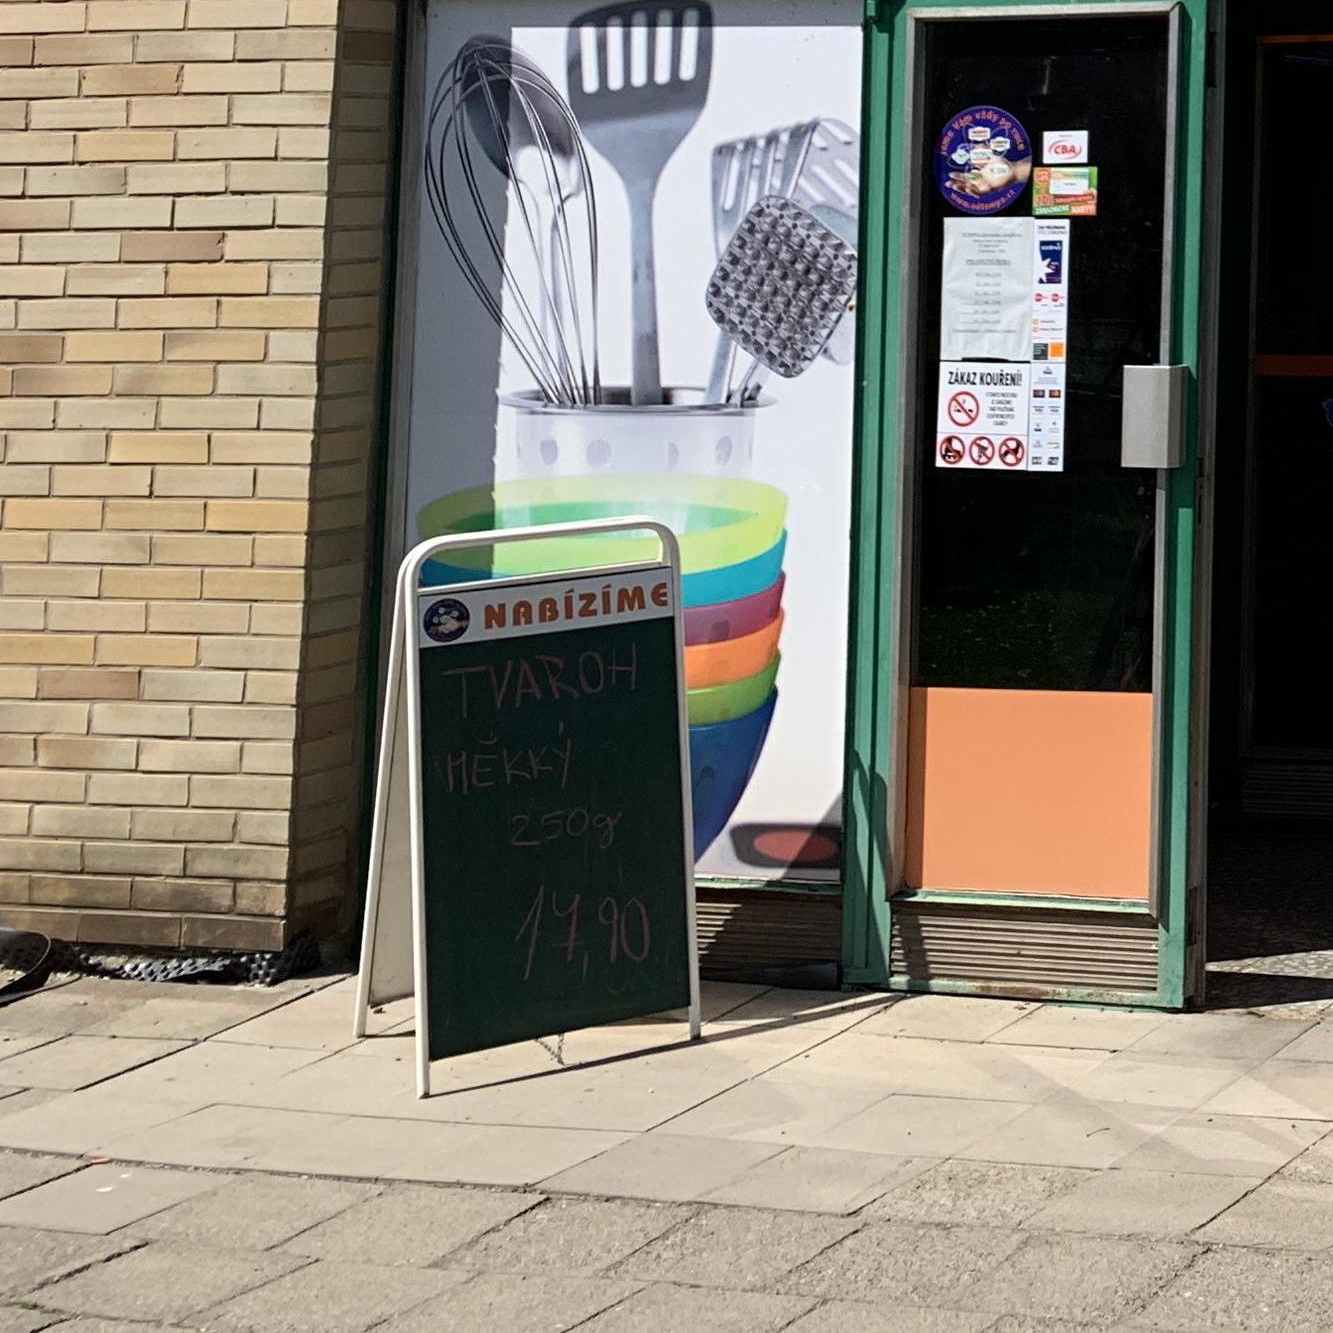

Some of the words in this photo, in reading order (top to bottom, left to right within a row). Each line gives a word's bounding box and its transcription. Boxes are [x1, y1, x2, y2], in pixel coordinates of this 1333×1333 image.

[1054, 144, 1077, 155] CBA
[947, 367, 977, 386] ZÁKAZ
[979, 368, 1023, 386] KOUŘENÍ!
[484, 583, 669, 630] NABÍZÍME
[441, 642, 636, 718] TVAROH
[445, 721, 573, 795] MĚKKÝ
[510, 808, 624, 850] 250g
[514, 884, 652, 983] 17,90
